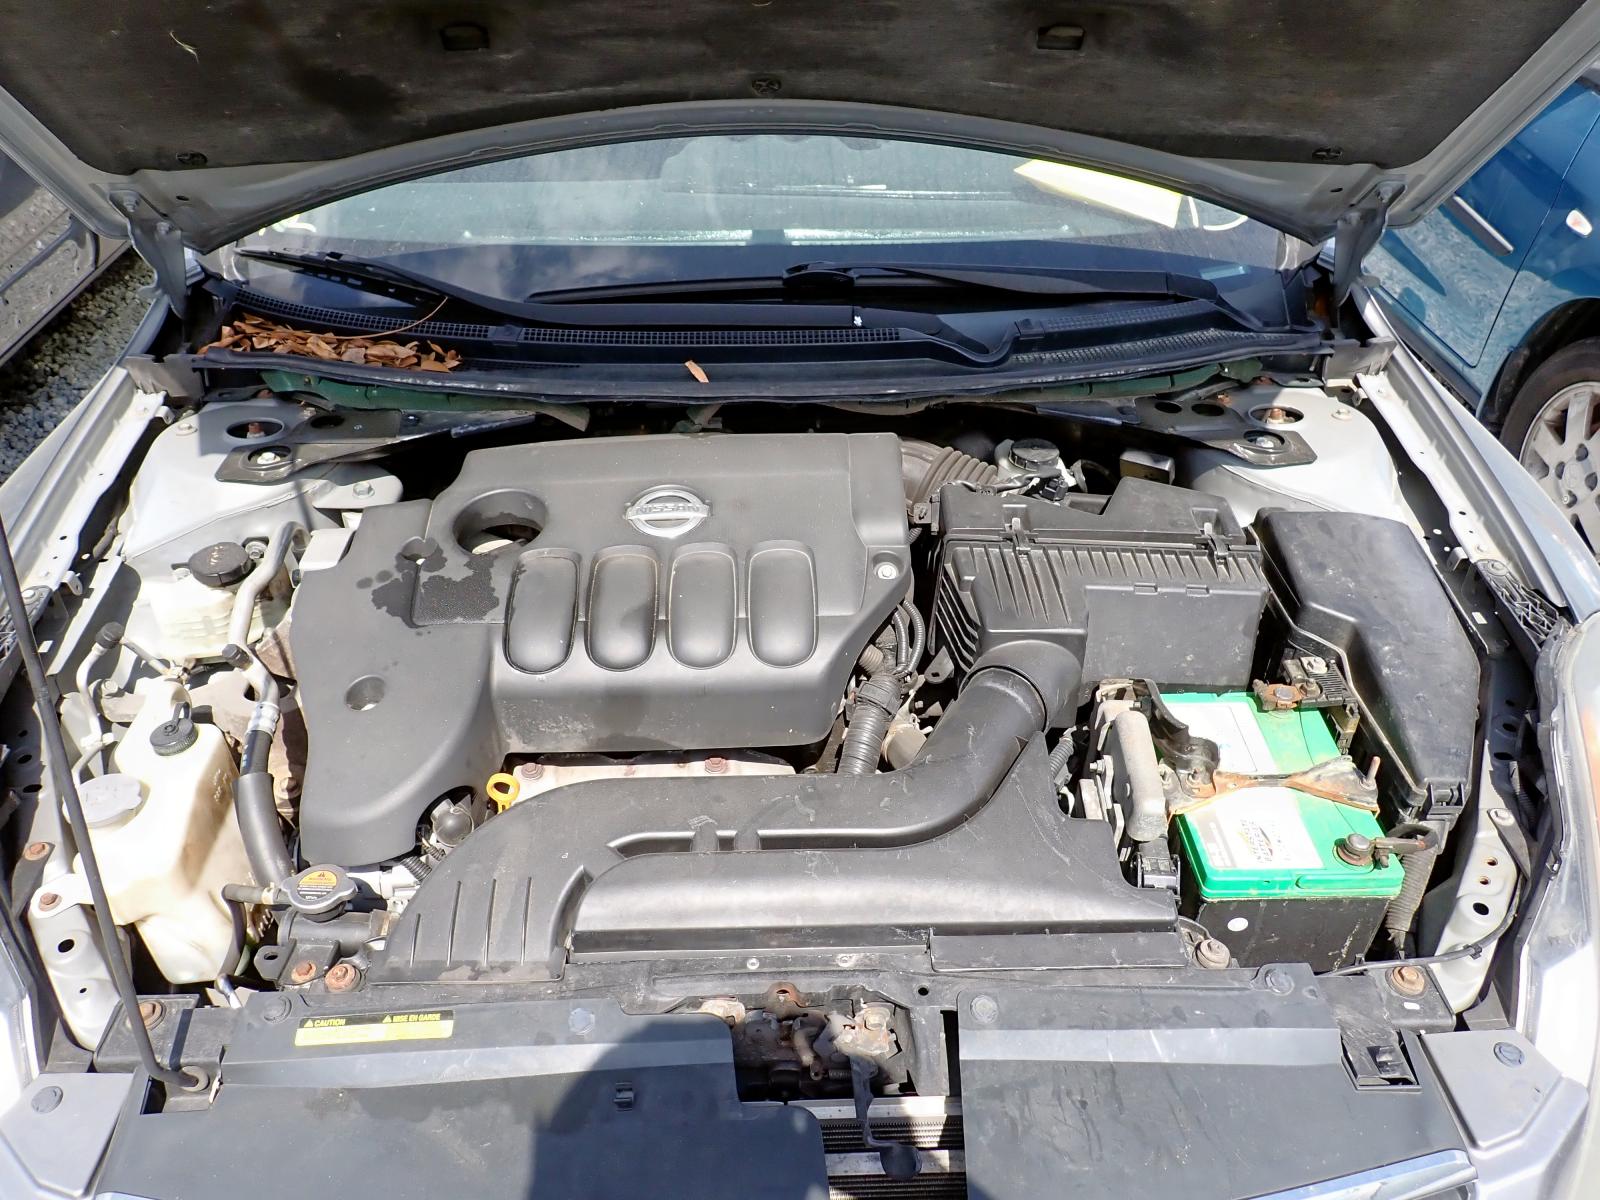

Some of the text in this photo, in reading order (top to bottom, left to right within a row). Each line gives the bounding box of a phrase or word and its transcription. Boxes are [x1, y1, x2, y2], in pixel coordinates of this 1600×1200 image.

[635, 503, 700, 514] NISSAN
[314, 1018, 346, 1027] CAUTION
[393, 1013, 441, 1023] MISE EN GARDE
